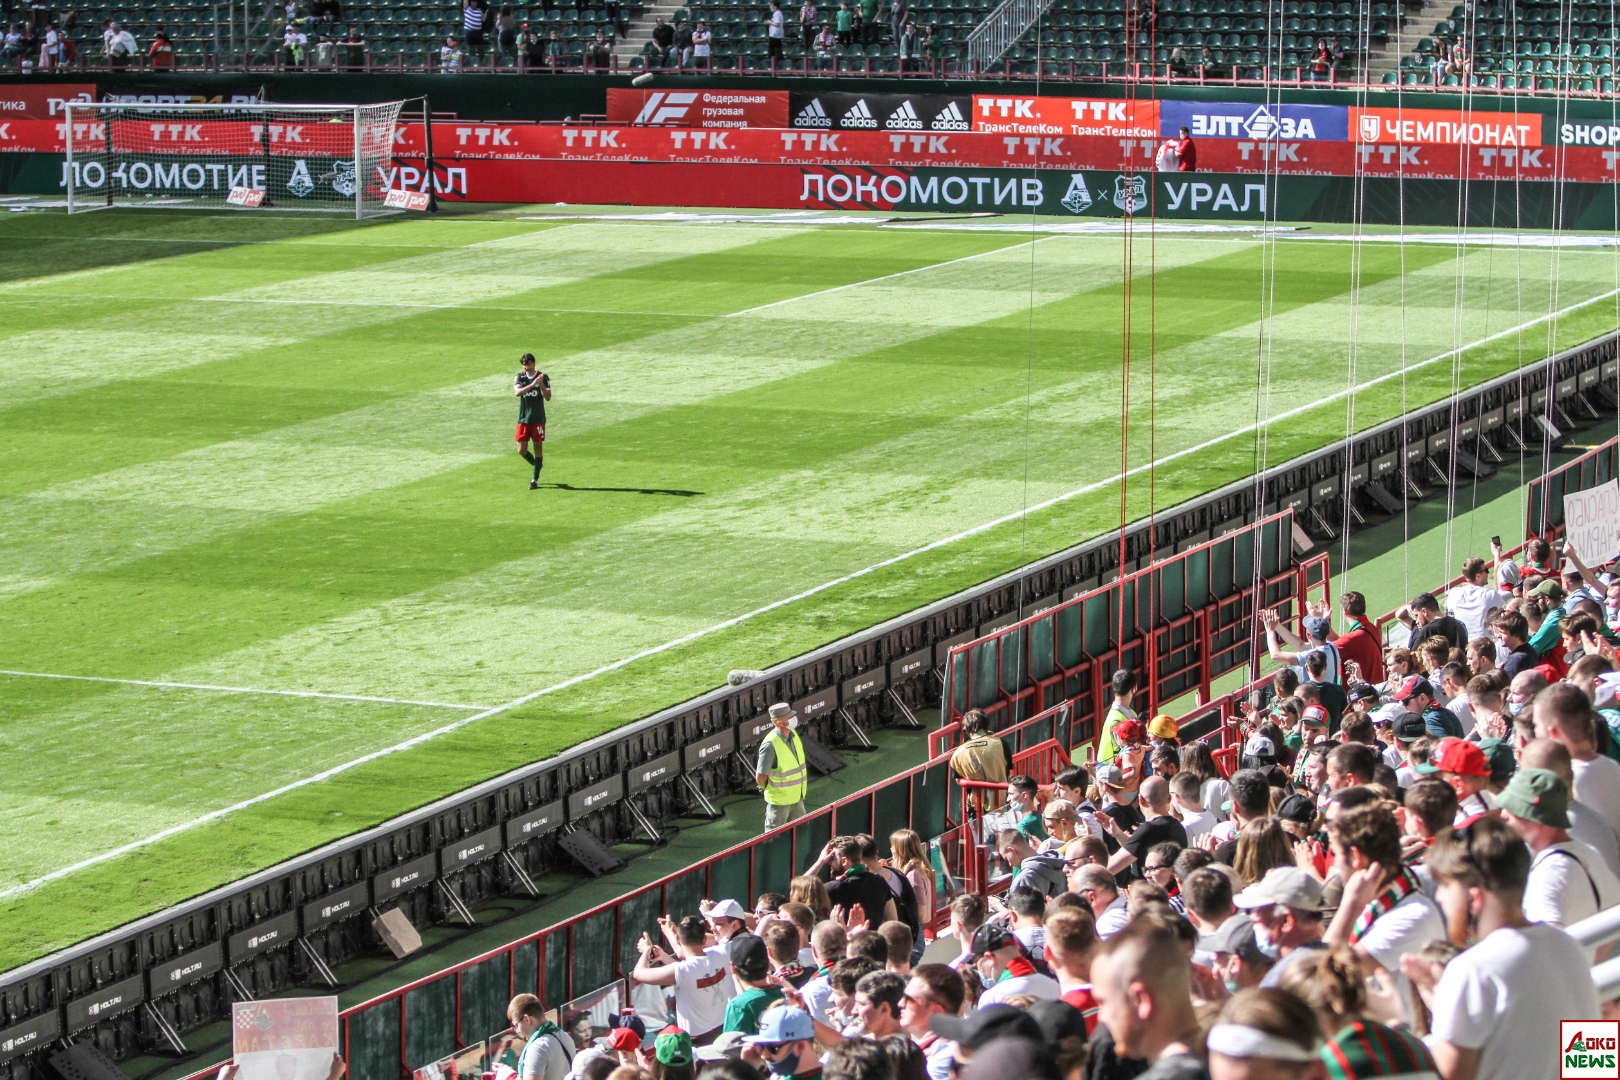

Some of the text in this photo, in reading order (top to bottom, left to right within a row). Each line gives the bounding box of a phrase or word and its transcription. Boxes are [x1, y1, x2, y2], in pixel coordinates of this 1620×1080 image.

[702, 94, 766, 104] Федеральная
[702, 107, 744, 118] грузовая
[978, 99, 1041, 118] ТТК.
[702, 120, 748, 128] компания
[794, 116, 832, 127] adidas
[840, 117, 878, 128] adidas
[886, 118, 923, 129] adidas
[932, 119, 968, 130] adidas
[978, 122, 1063, 134] ТрансТелеКом
[456, 128, 518, 146] ТТК.
[562, 130, 626, 148] ТТК.
[1071, 125, 1156, 137] ТрансТелеКом
[1386, 120, 1530, 146] ЧЕМПИОНАТ
[670, 132, 736, 150] ТТК.
[780, 133, 847, 152] ТТК.
[889, 135, 956, 154] ТТК.
[1003, 137, 1072, 156] ТТК.
[1238, 142, 1308, 162] ТТК.
[1358, 145, 1428, 165] ТТК.
[1479, 148, 1552, 168] ТТК.
[800, 174, 1044, 206] ЛОКОМОТИВ
[1164, 182, 1264, 212] УРАЛ
